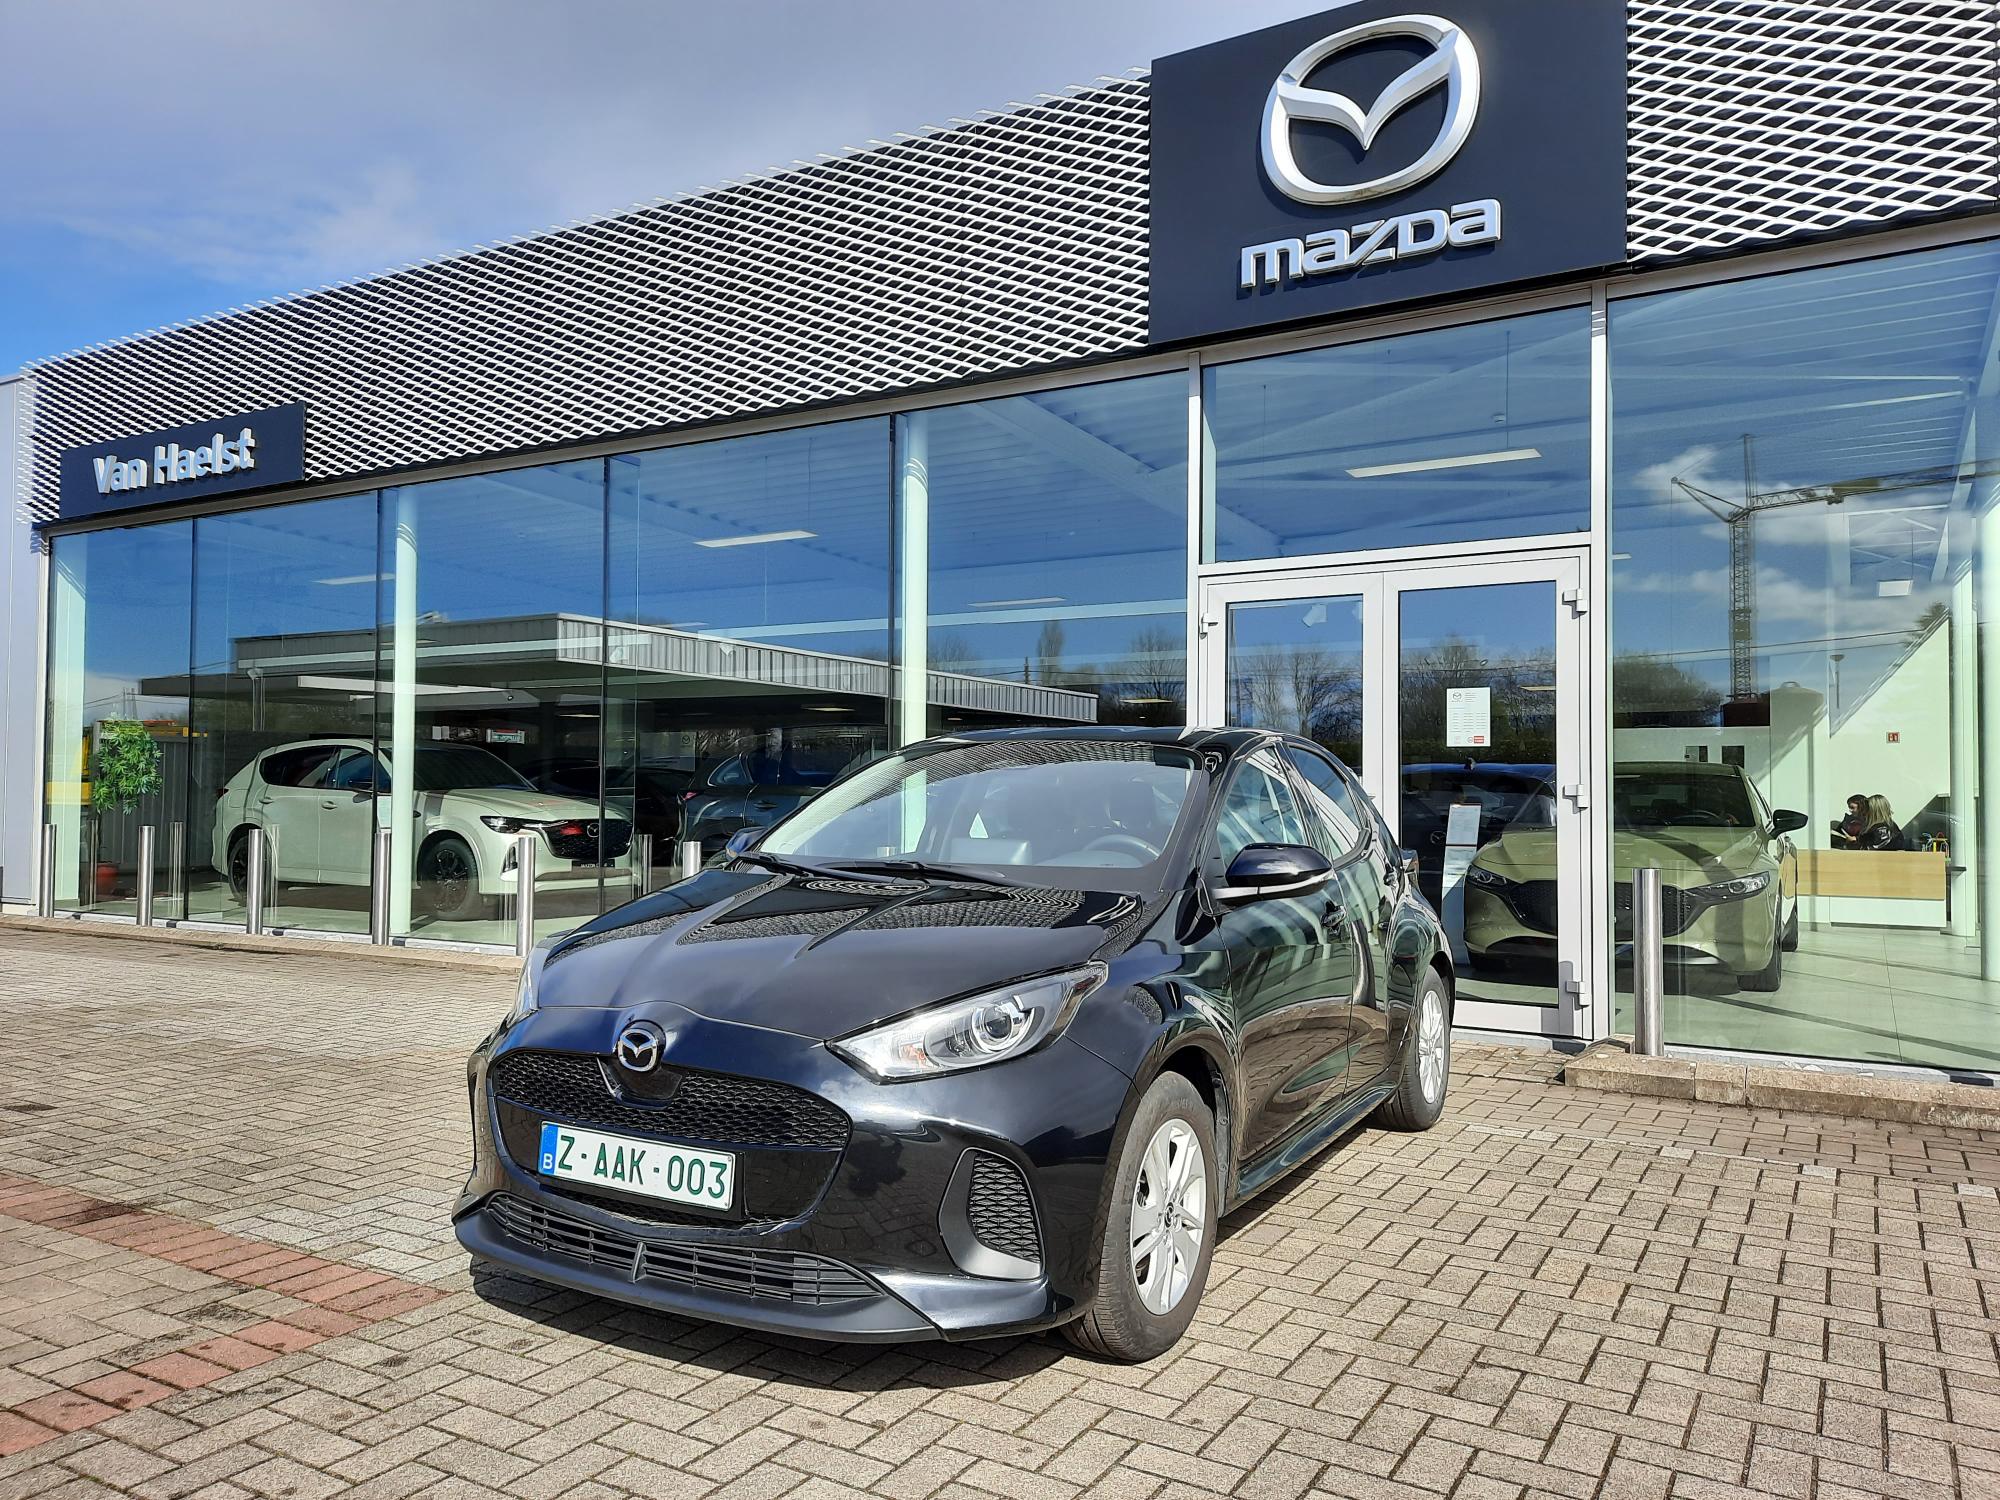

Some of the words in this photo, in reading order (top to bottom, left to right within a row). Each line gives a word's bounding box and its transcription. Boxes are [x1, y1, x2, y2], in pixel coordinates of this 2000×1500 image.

[93, 455, 148, 494] Van
[153, 428, 256, 485] Haelst
[542, 1153, 553, 1170] B
[557, 1134, 728, 1199] Z-AAK-003
